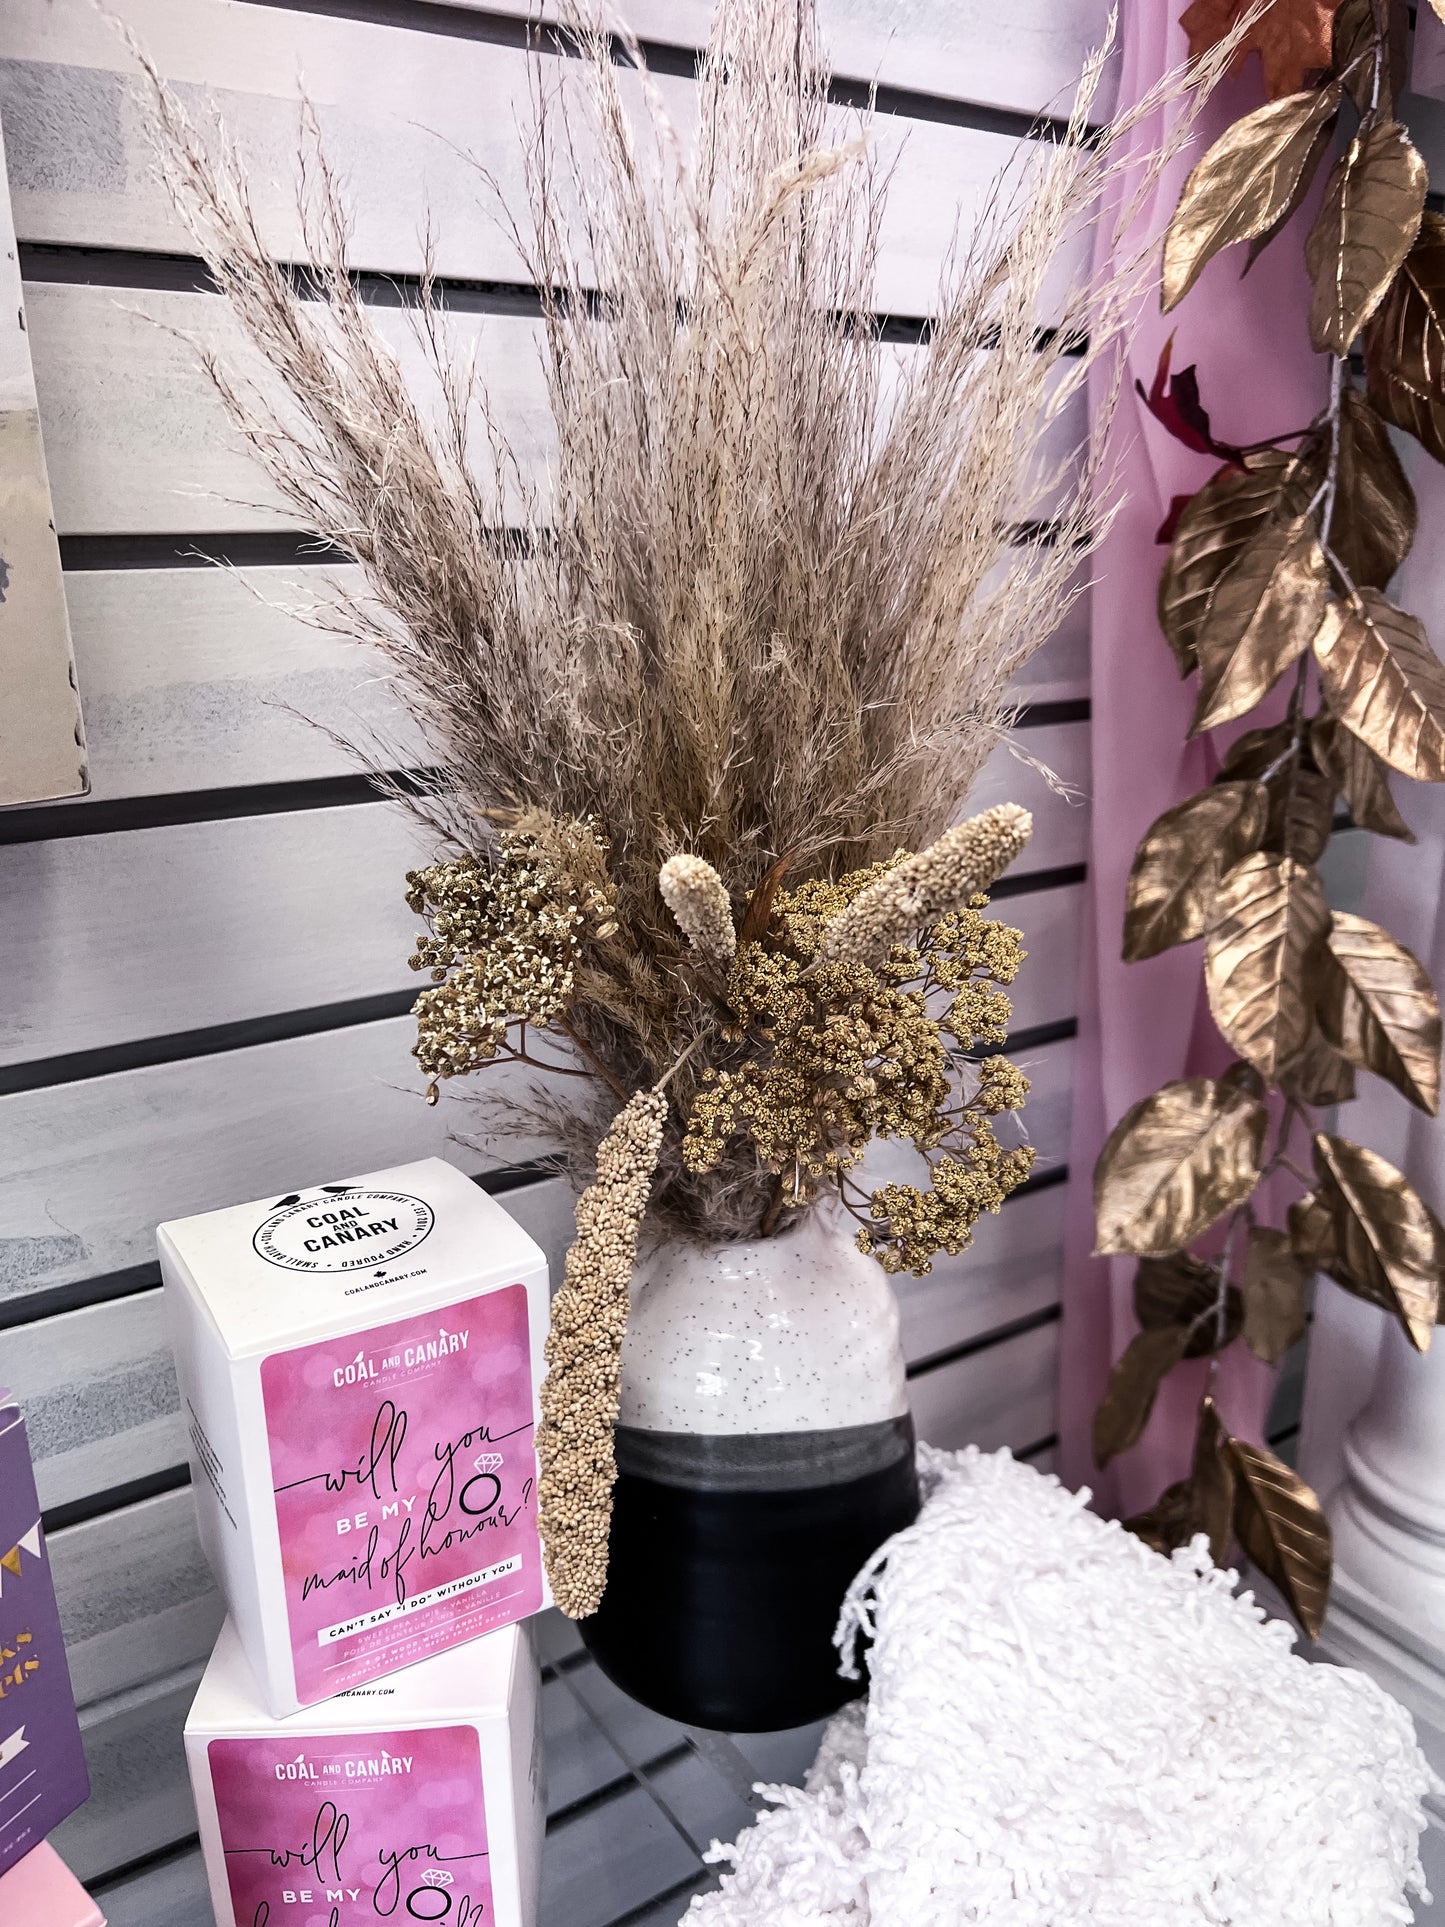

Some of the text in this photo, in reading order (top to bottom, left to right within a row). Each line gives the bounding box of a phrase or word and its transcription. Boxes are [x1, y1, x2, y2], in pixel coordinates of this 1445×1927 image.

[323, 1195, 362, 1204] CANDLE
[366, 1193, 411, 1204] COMPANY
[306, 1206, 370, 1229] COAL
[332, 1219, 359, 1232] AND
[303, 1217, 399, 1252] CANARY
[386, 1239, 413, 1255] HAND
[285, 1257, 319, 1269] SMALL
[341, 1253, 385, 1268] POURED
[344, 1268, 428, 1296] COALANDCANARY.COM
[333, 1329, 470, 1388] COAL AND CANARY
[363, 1361, 442, 1389] CANDLE COMPANY
[274, 1400, 408, 1500] will
[429, 1422, 534, 1521] you
[336, 1496, 417, 1535] BE MY
[302, 1525, 379, 1601] maid
[380, 1517, 416, 1605] of
[329, 1618, 366, 1638] CAN'T
[371, 1609, 393, 1623] SAY
[437, 1573, 488, 1598] WITHOUT
[492, 1561, 514, 1577] YOU
[450, 1589, 488, 1608] VANILLA
[274, 1756, 413, 1780] COAL AND CANARY
[341, 1777, 384, 1785] COMPANY
[225, 1801, 350, 1883] will
[373, 1845, 490, 1916] you
[283, 1888, 361, 1904] BE MY
